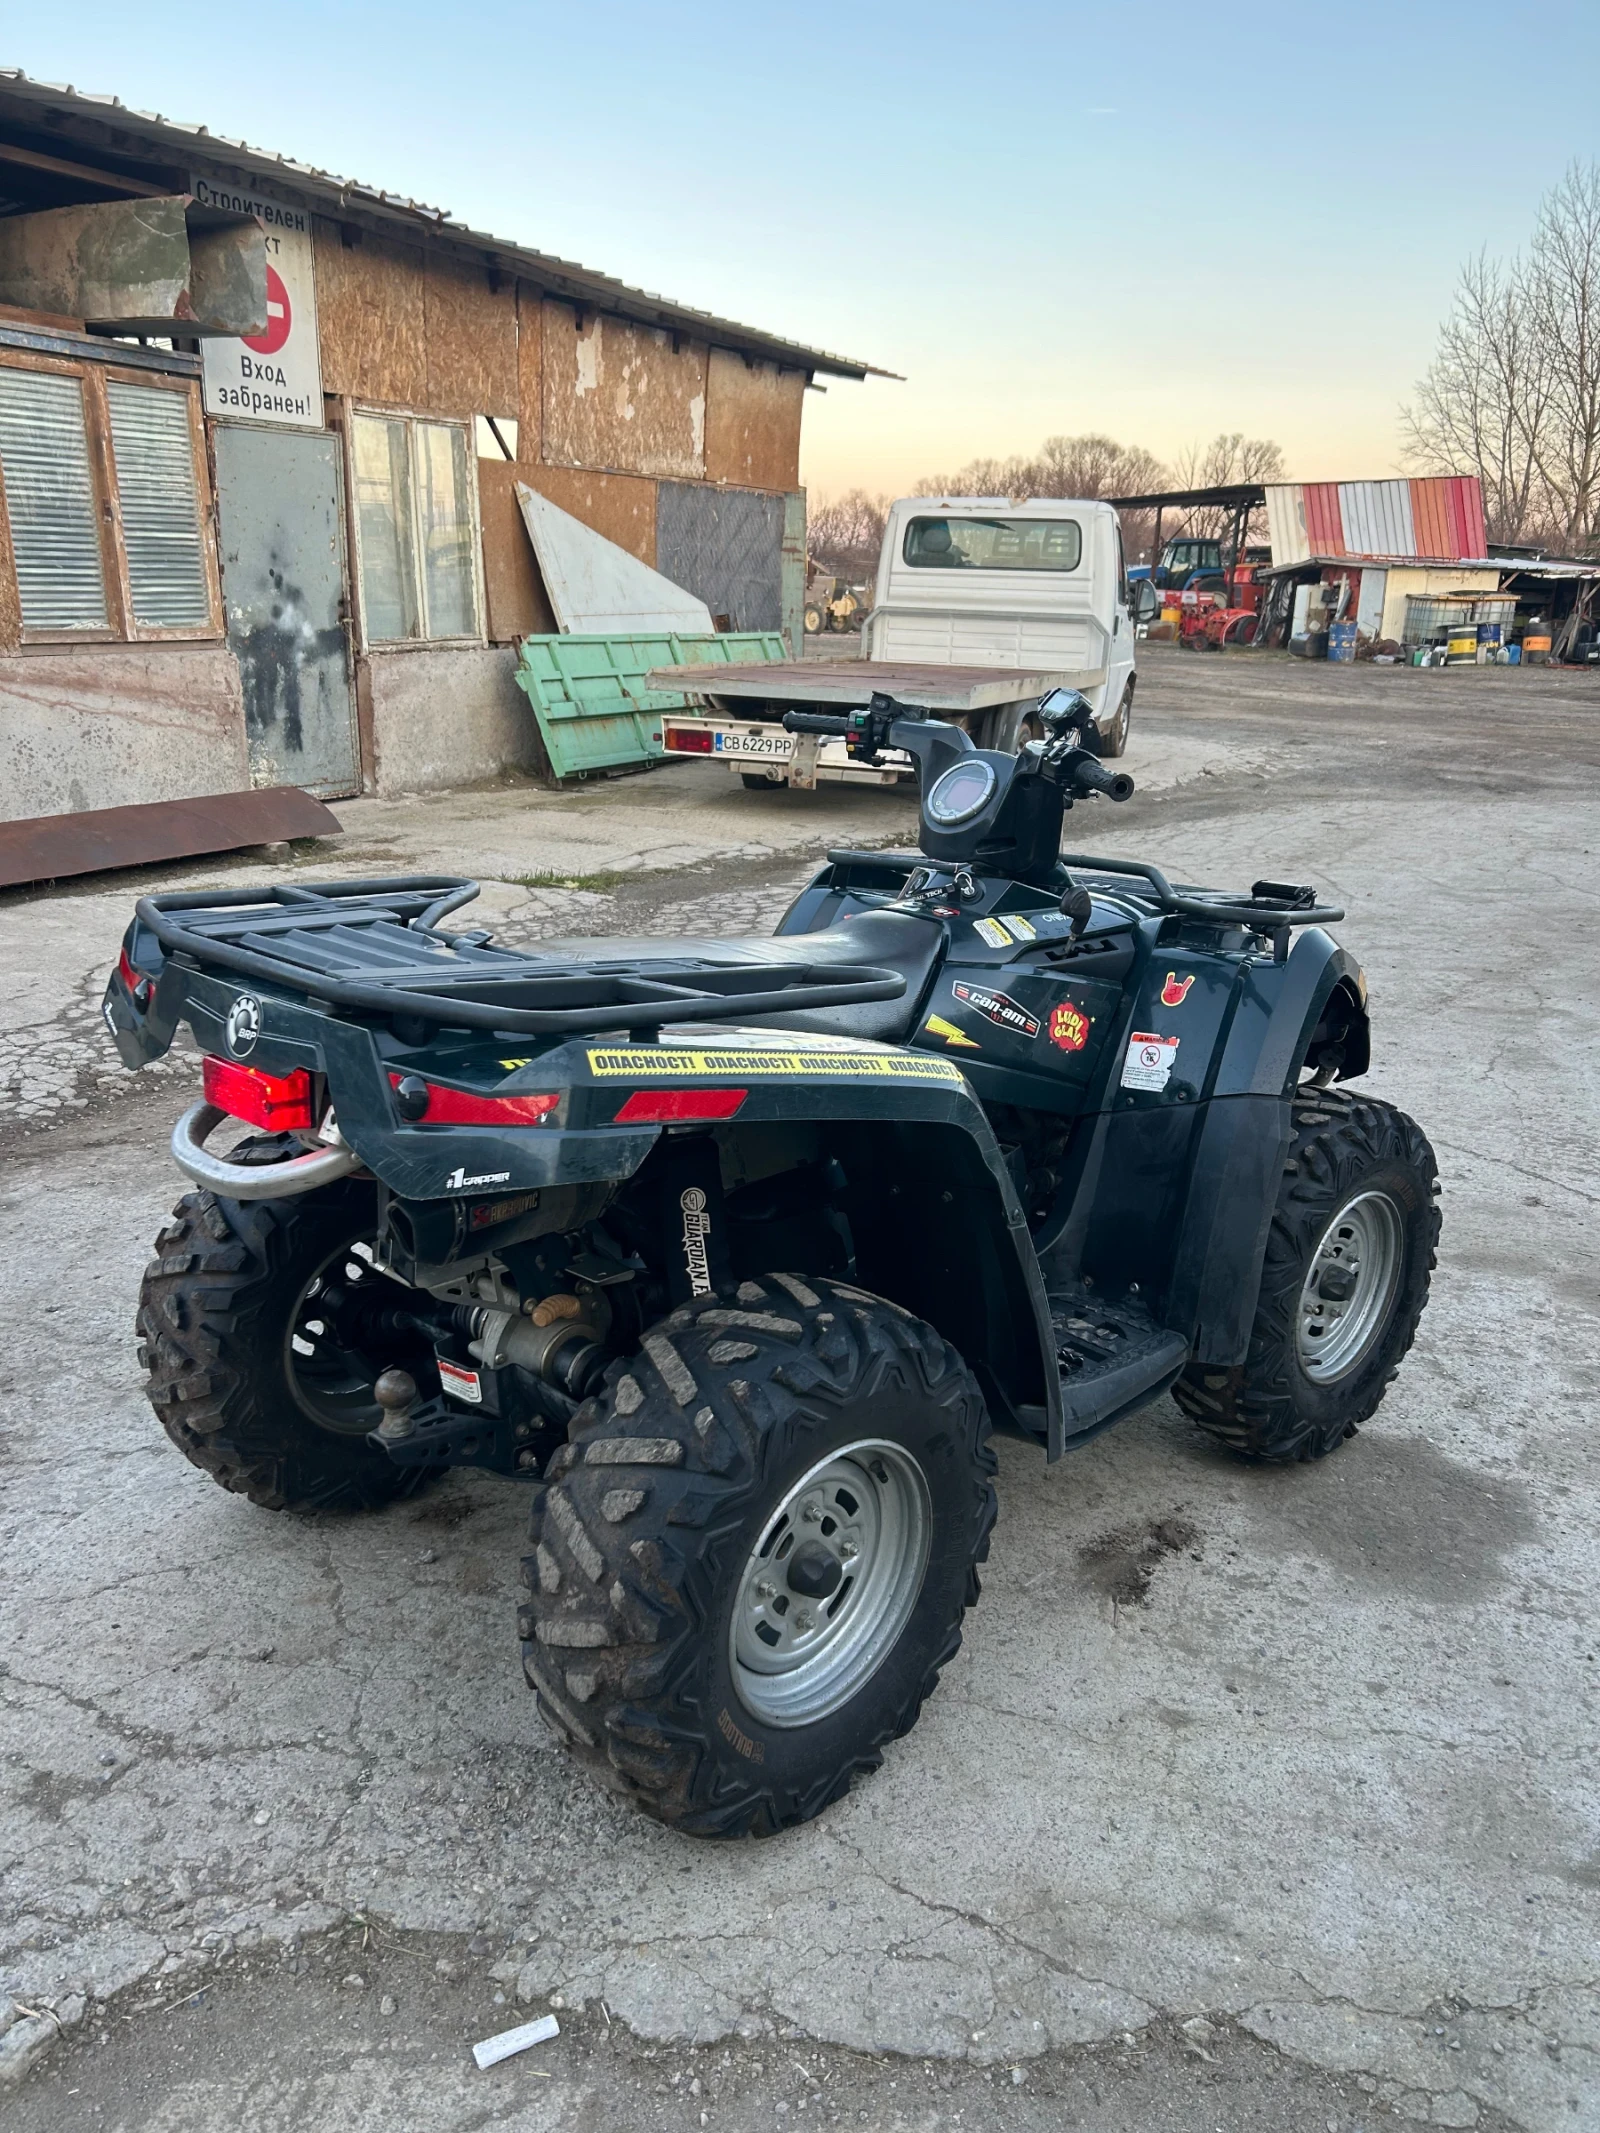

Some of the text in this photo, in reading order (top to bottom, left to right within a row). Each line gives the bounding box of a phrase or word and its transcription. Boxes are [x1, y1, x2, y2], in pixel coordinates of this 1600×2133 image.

[240, 355, 286, 387] Вход
[218, 387, 311, 416] забранен!
[724, 736, 792, 754] CB 6229 PP
[1057, 1010, 1084, 1032] LUDI
[238, 1027, 257, 1041] BRP
[1054, 1024, 1084, 1047] GLAVI
[595, 1055, 697, 1069] ОПАСНОСТ!
[704, 1056, 796, 1070] ОПАСНОСТ!
[800, 1057, 883, 1071] ОПАСНОСТ!
[700, 1215, 709, 1232] TEAM
[685, 1213, 708, 1280] GUARDIAN
[717, 1707, 754, 1759] BULLDOG
